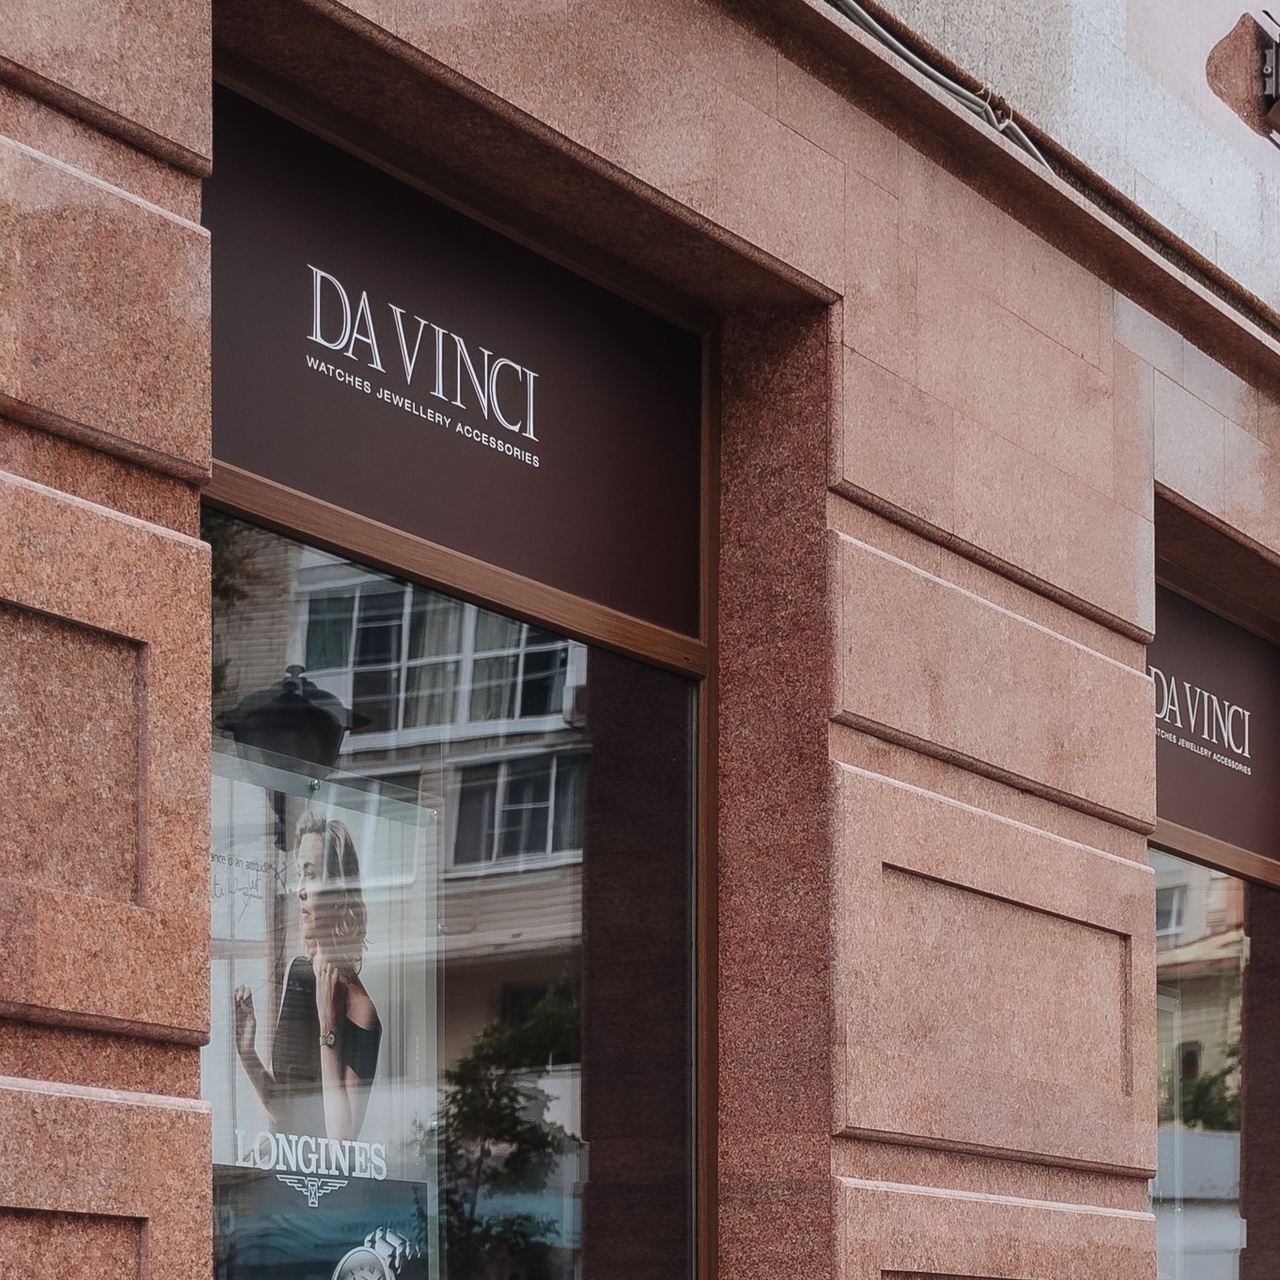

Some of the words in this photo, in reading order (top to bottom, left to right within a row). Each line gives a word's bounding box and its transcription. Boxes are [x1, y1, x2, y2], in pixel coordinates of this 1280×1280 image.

[306, 263, 386, 373] DA
[388, 303, 540, 443] VINCI
[306, 354, 372, 394] WATCHES
[376, 387, 452, 429] JEWELLERY
[455, 422, 541, 468] ACCESSORIES
[1155, 728, 1177, 744] TCHES
[1177, 738, 1212, 759] JEWELLERY
[1212, 752, 1252, 776] ACCESSORIES
[1182, 681, 1251, 759] VINCI
[235, 1129, 388, 1181] LONGINES
